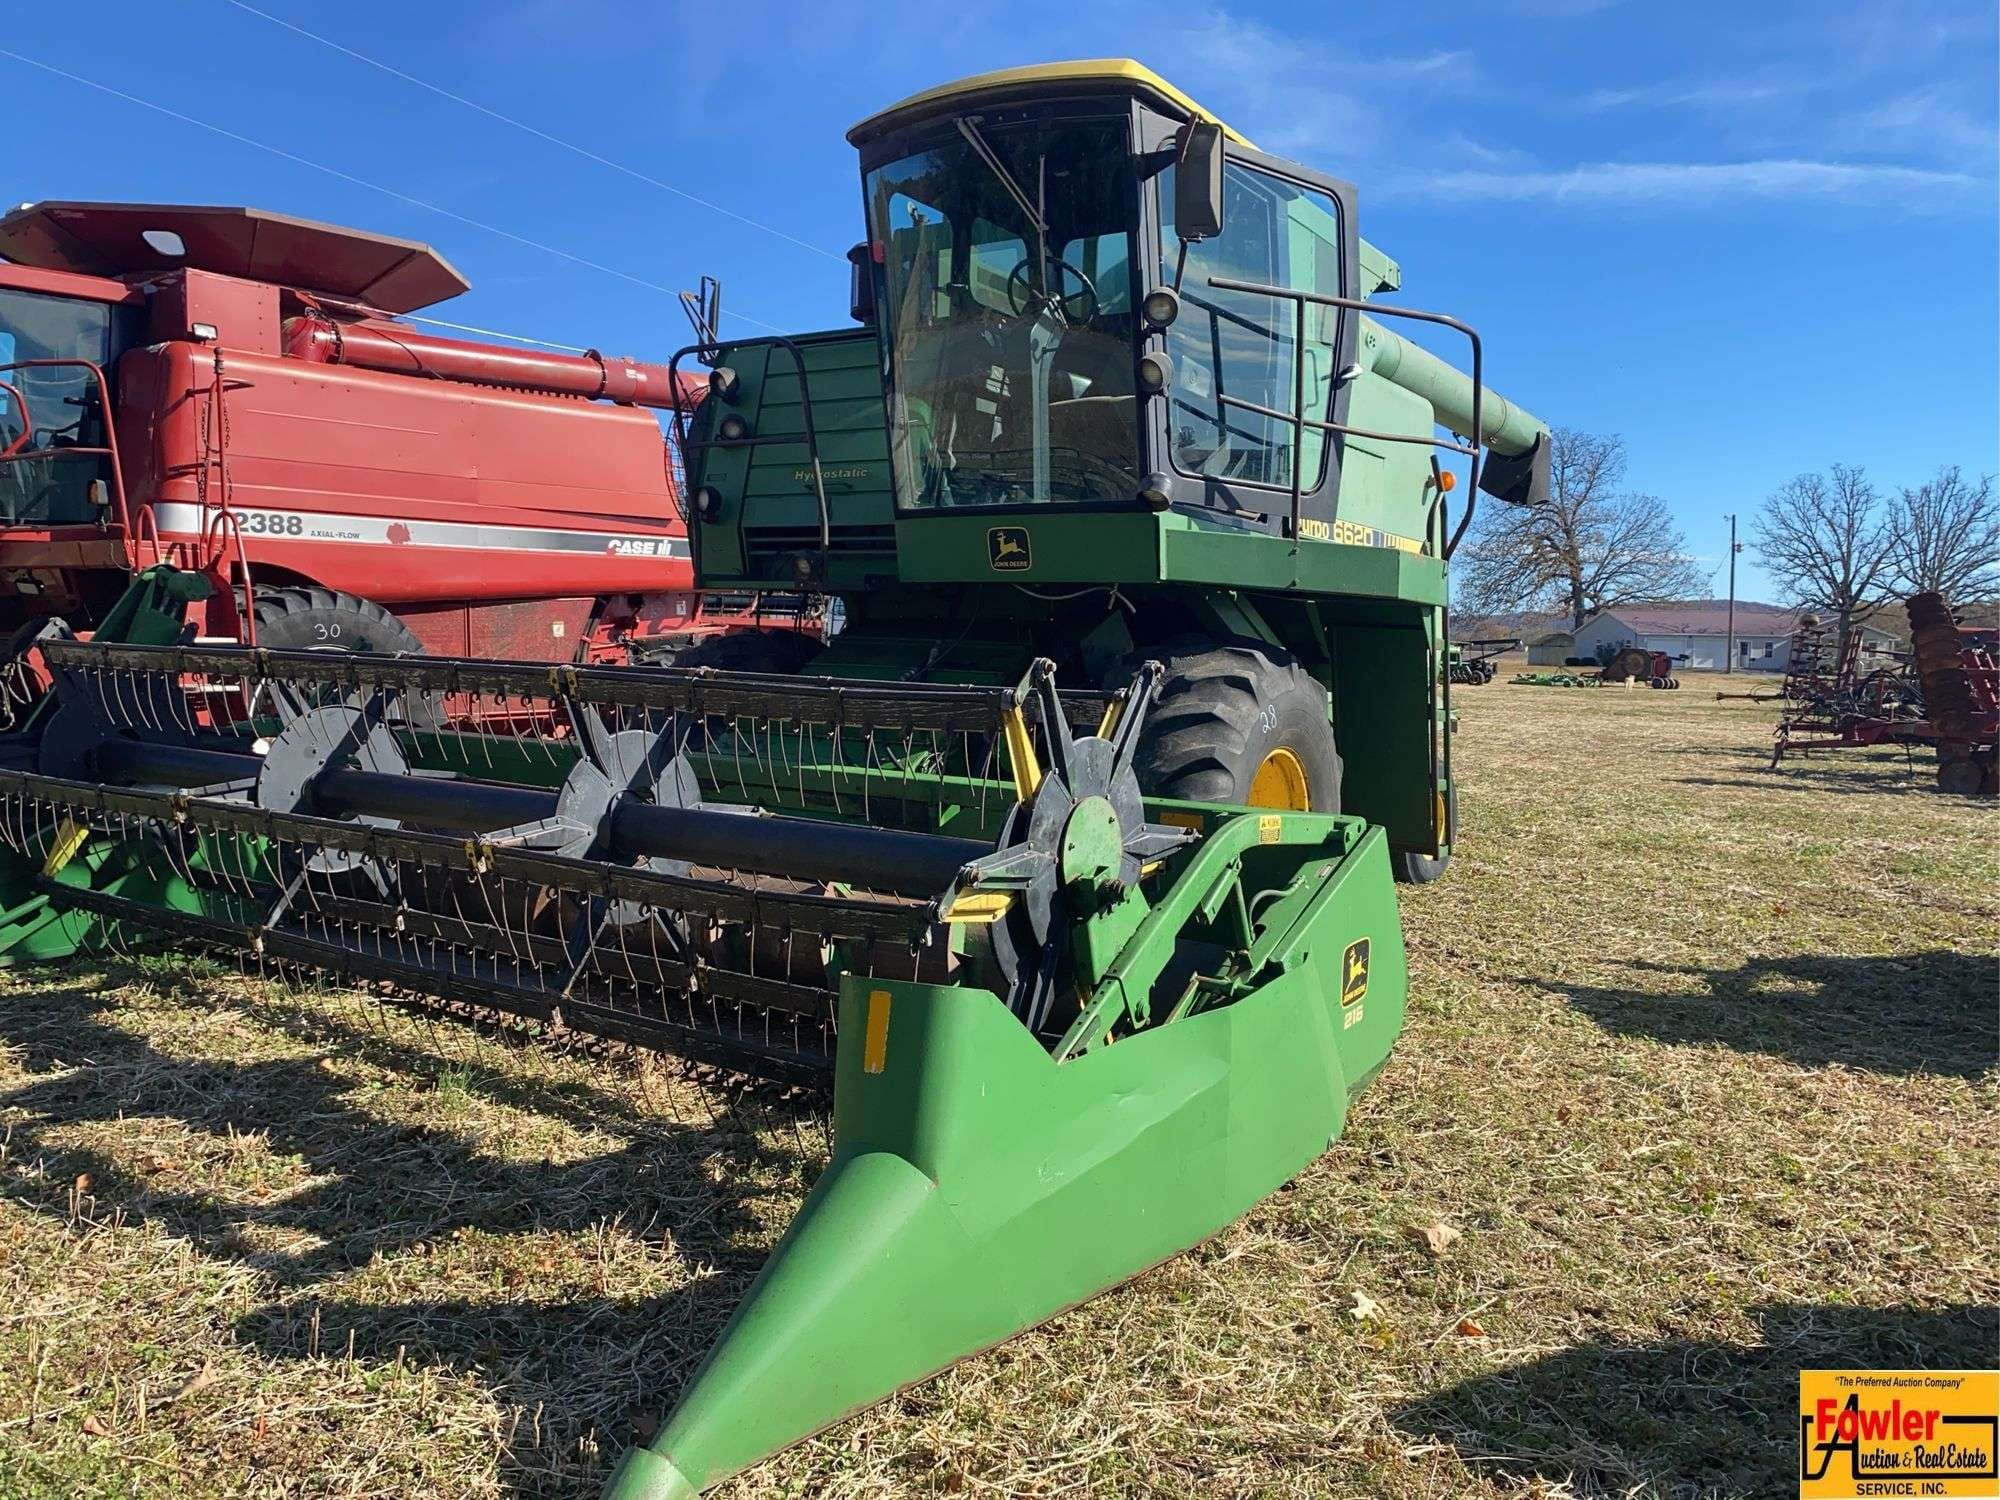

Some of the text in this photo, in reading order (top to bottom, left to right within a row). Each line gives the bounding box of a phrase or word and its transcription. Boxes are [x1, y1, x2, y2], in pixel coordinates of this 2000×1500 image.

[232, 512, 360, 539] 2388 AXIAL-FLOW
[1333, 521, 1374, 547] 6620
[608, 539, 655, 555] CASE
[314, 623, 341, 640] 30
[1260, 704, 1278, 734] 28
